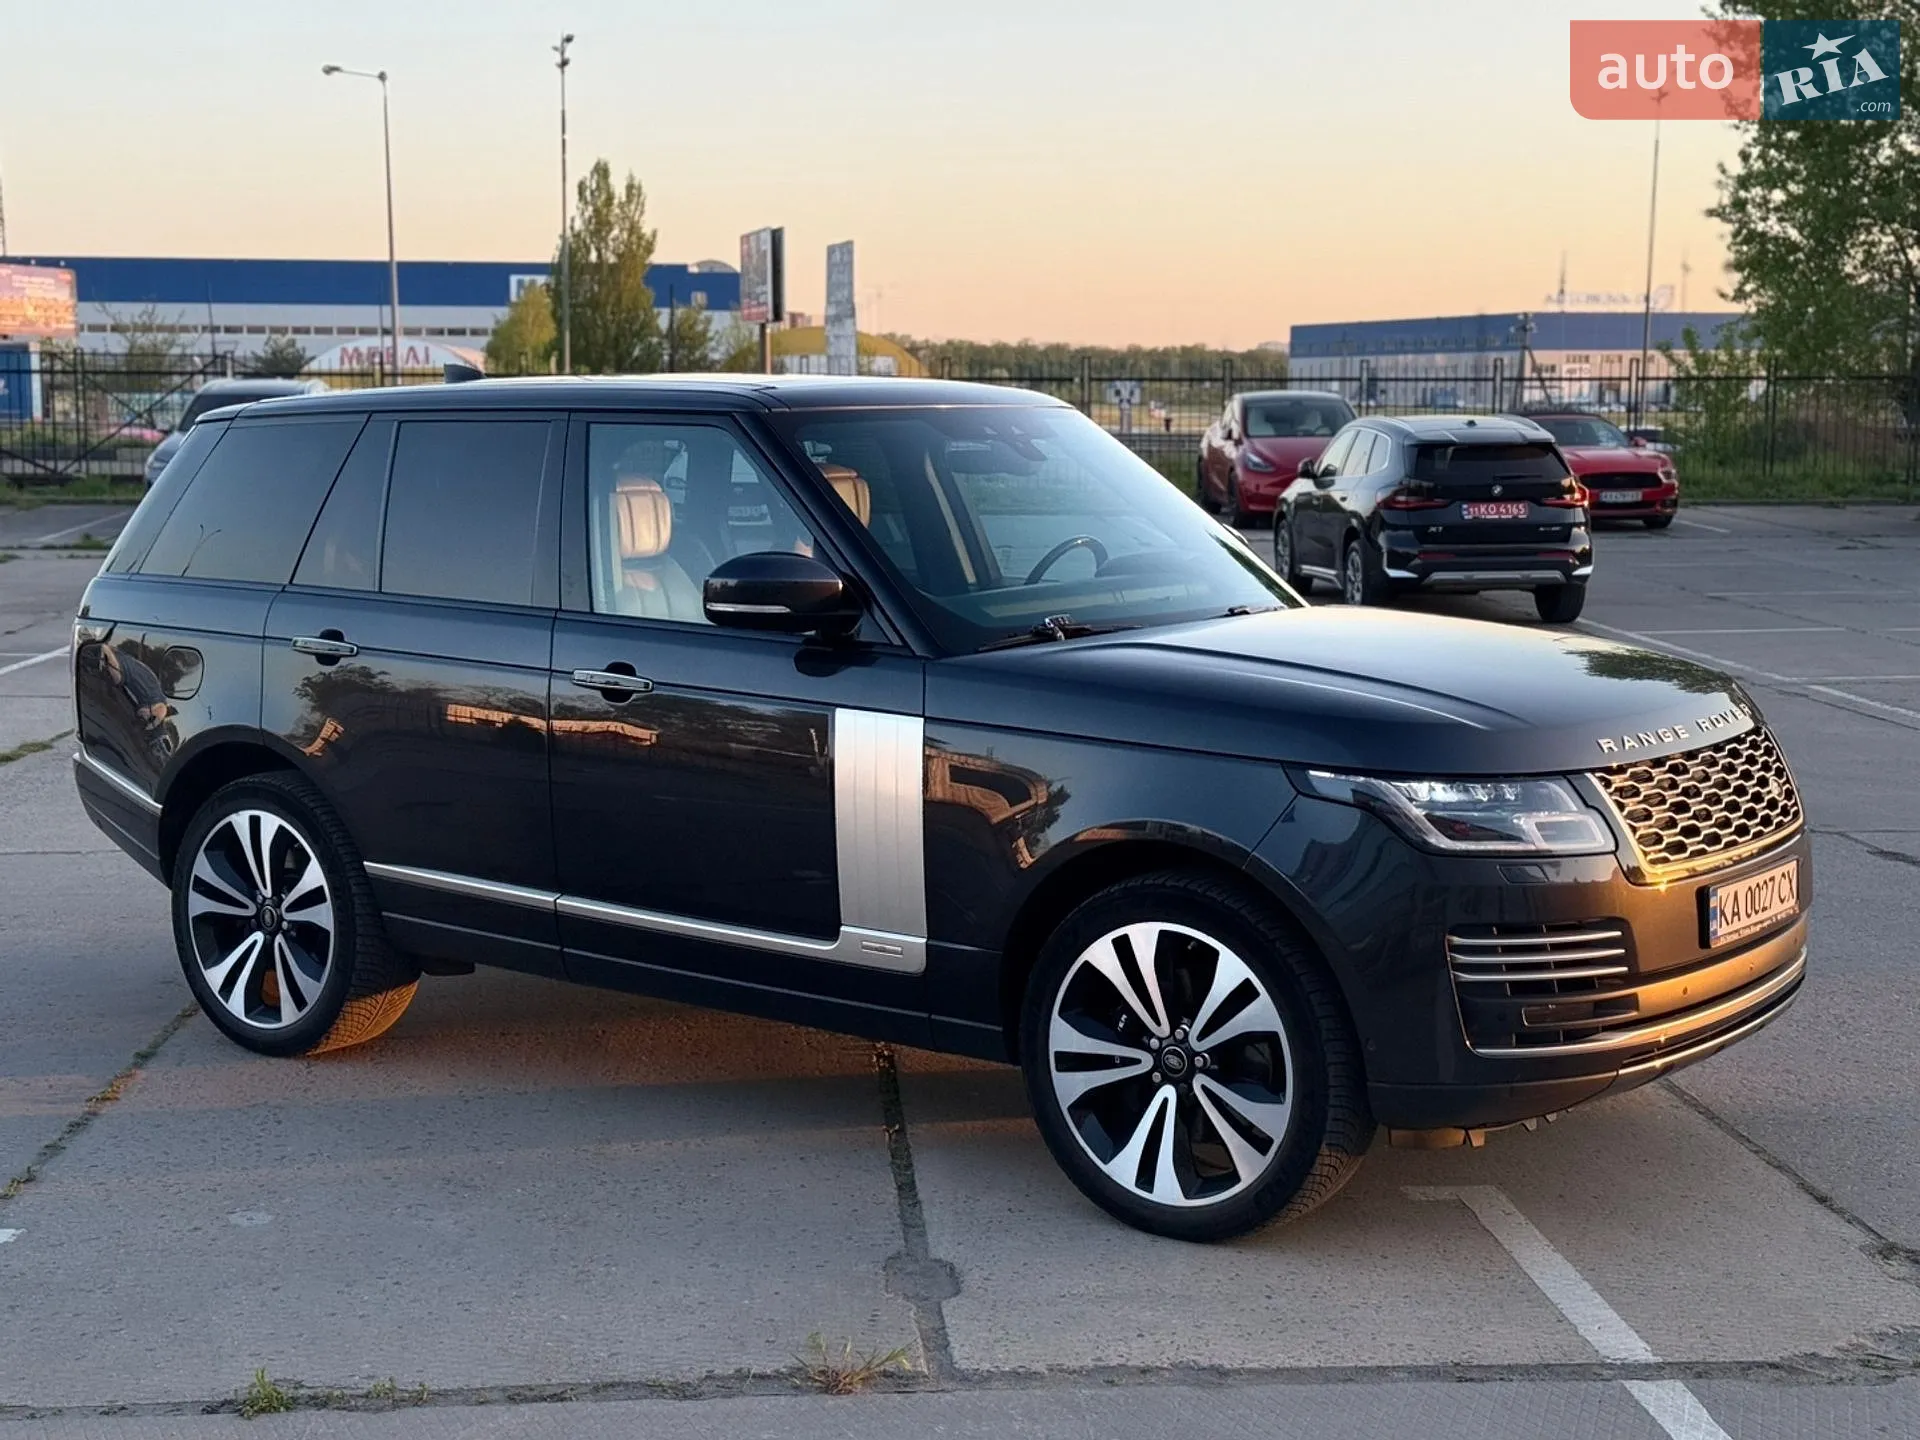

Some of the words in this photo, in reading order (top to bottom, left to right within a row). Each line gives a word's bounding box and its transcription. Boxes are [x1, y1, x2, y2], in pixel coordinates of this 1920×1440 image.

[1597, 724, 1690, 754] RANGE
[1695, 702, 1752, 733] ROVER
[1718, 889, 1741, 930] KA
[1745, 875, 1776, 920] 0027
[1778, 866, 1797, 905] CX
